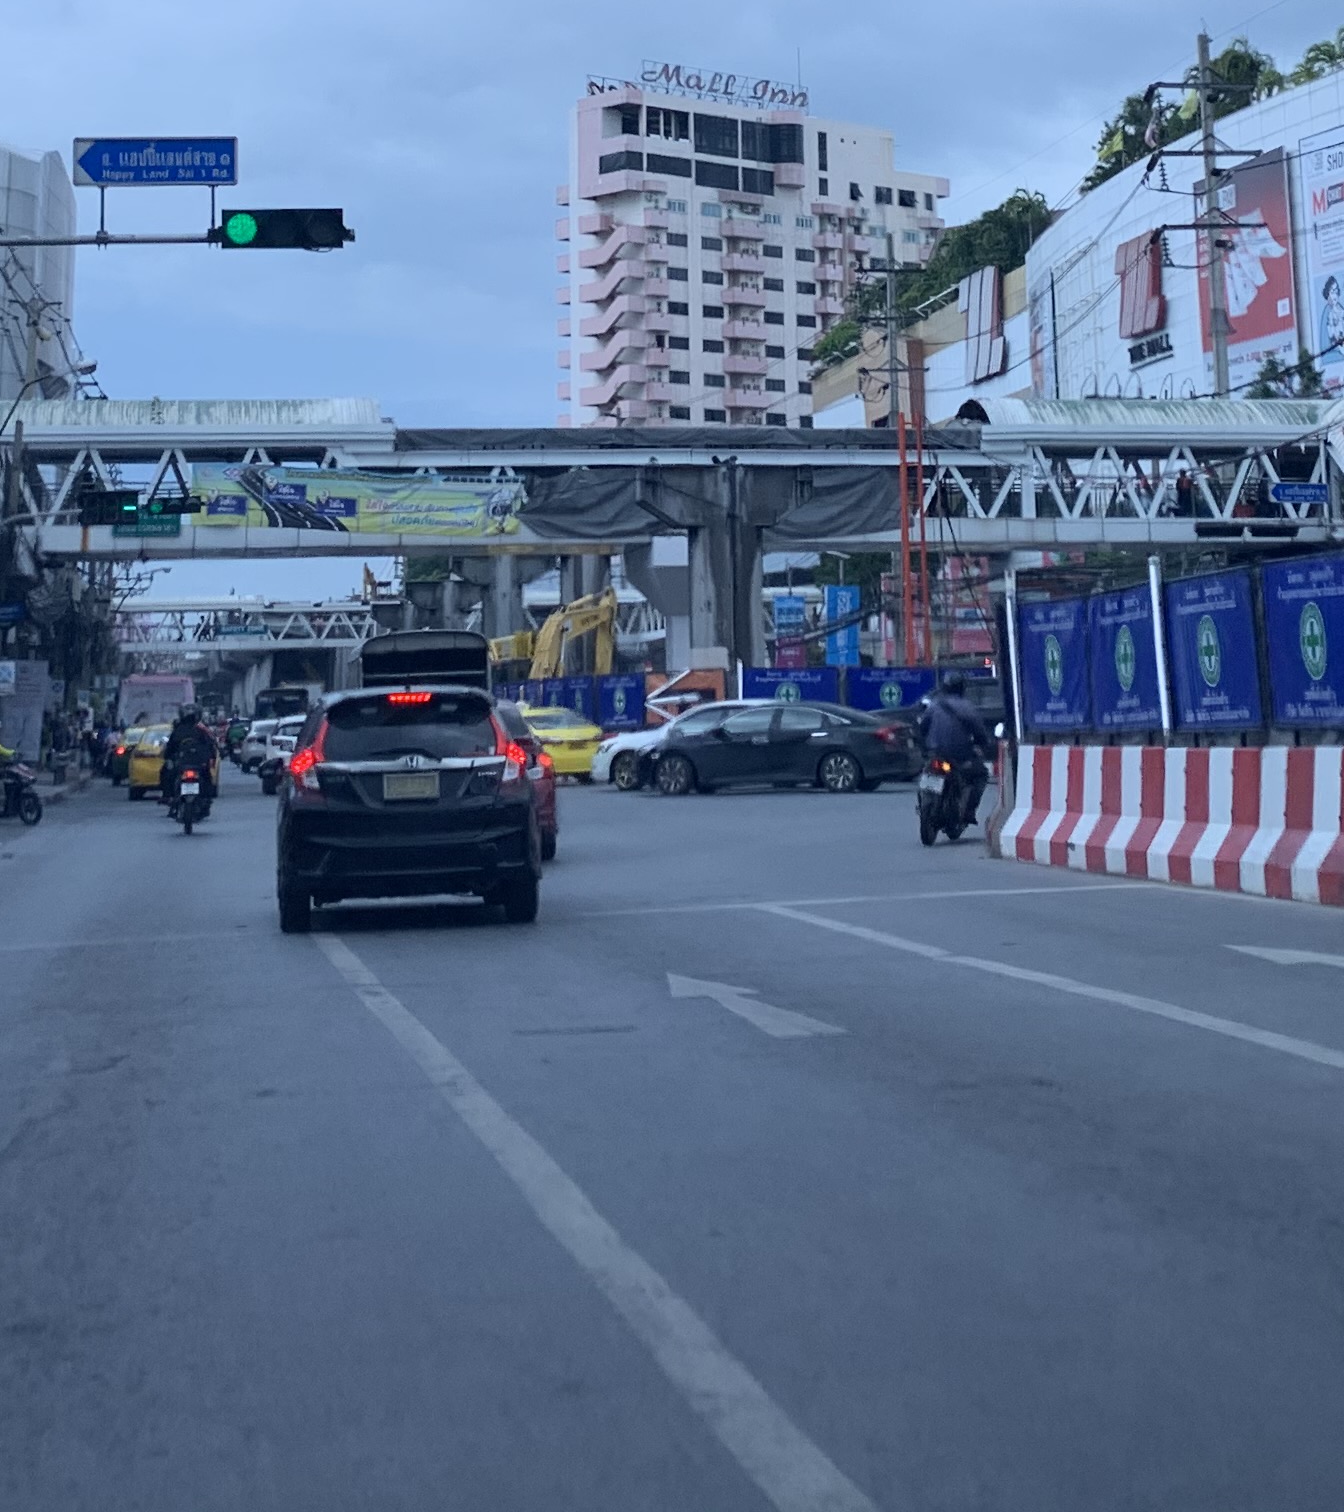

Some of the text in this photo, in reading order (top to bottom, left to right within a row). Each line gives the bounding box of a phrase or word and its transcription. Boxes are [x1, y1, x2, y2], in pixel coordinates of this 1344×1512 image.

[641, 63, 736, 96] Mall
[749, 79, 809, 108] Inn
[102, 169, 135, 180] Happy
[143, 168, 169, 179] Land
